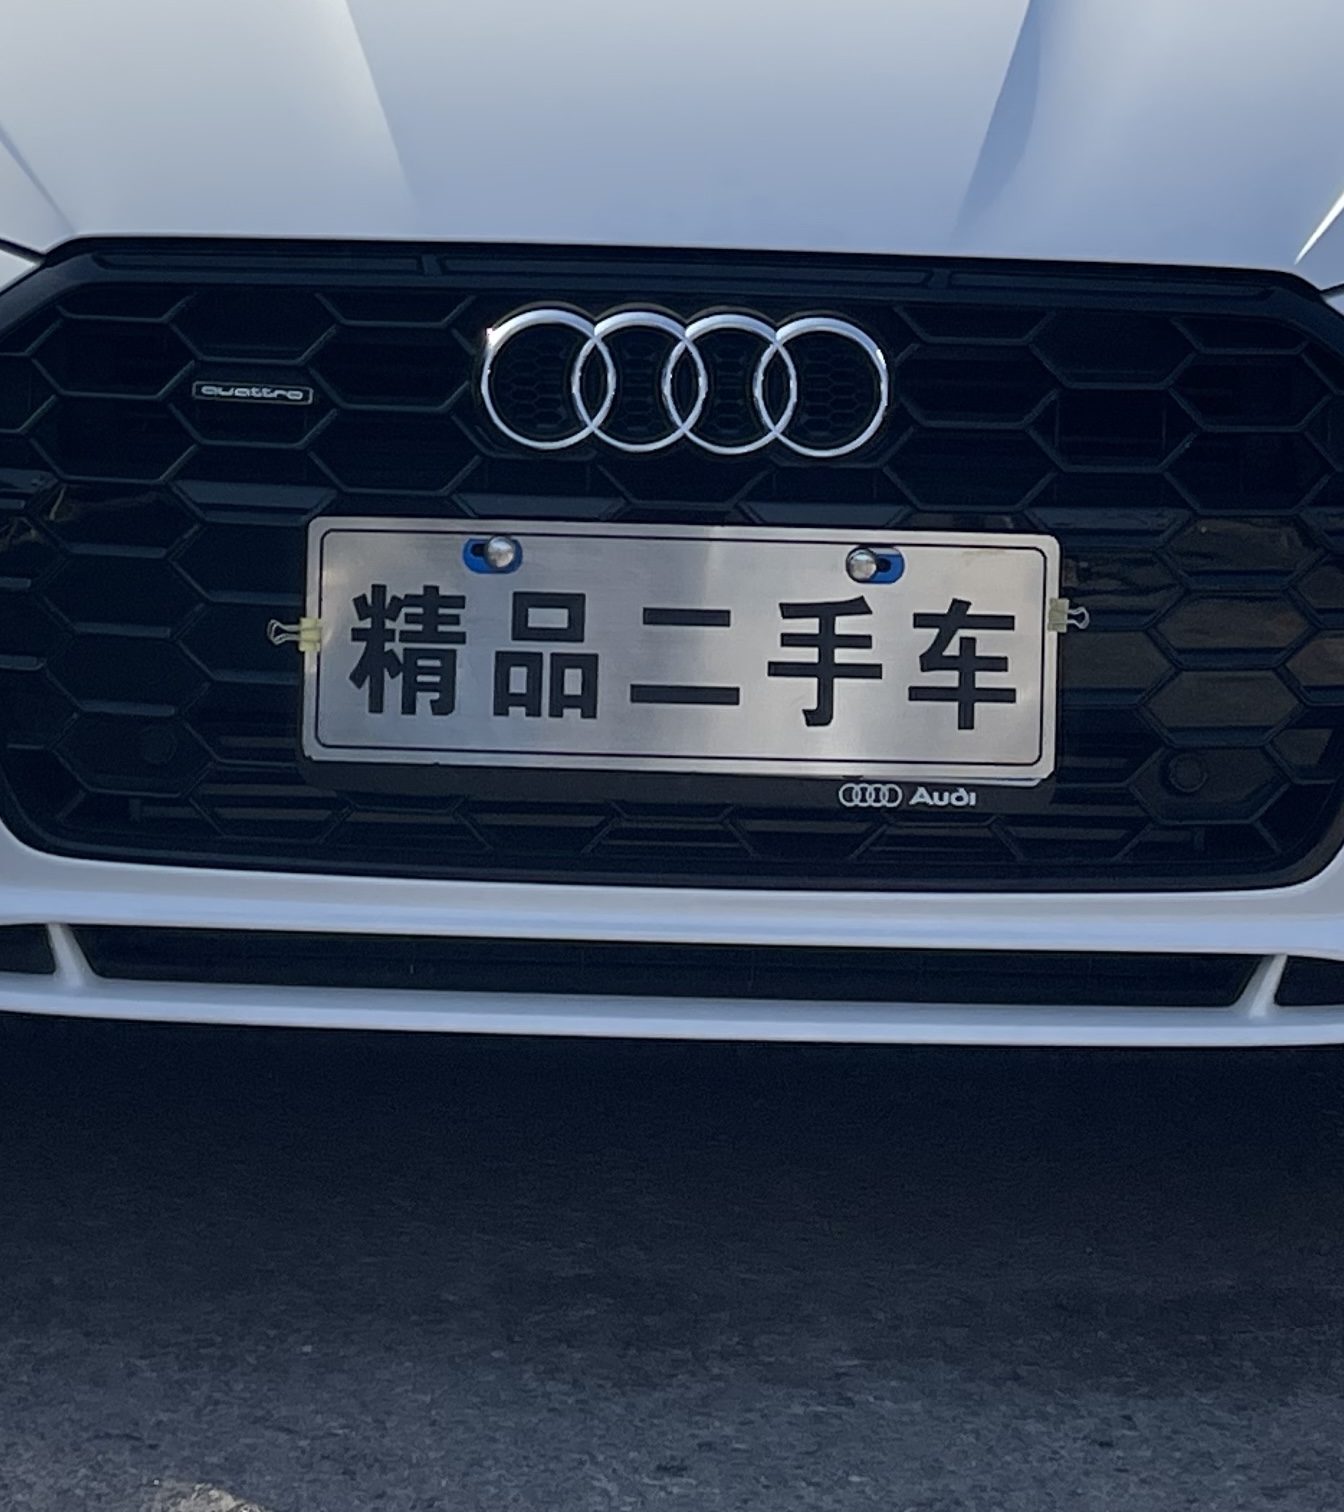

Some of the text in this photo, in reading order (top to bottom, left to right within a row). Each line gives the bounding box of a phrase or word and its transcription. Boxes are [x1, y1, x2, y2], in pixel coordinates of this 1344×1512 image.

[201, 385, 304, 400] quattro
[350, 582, 1019, 731] 精品二手车
[908, 786, 977, 807] Audi
